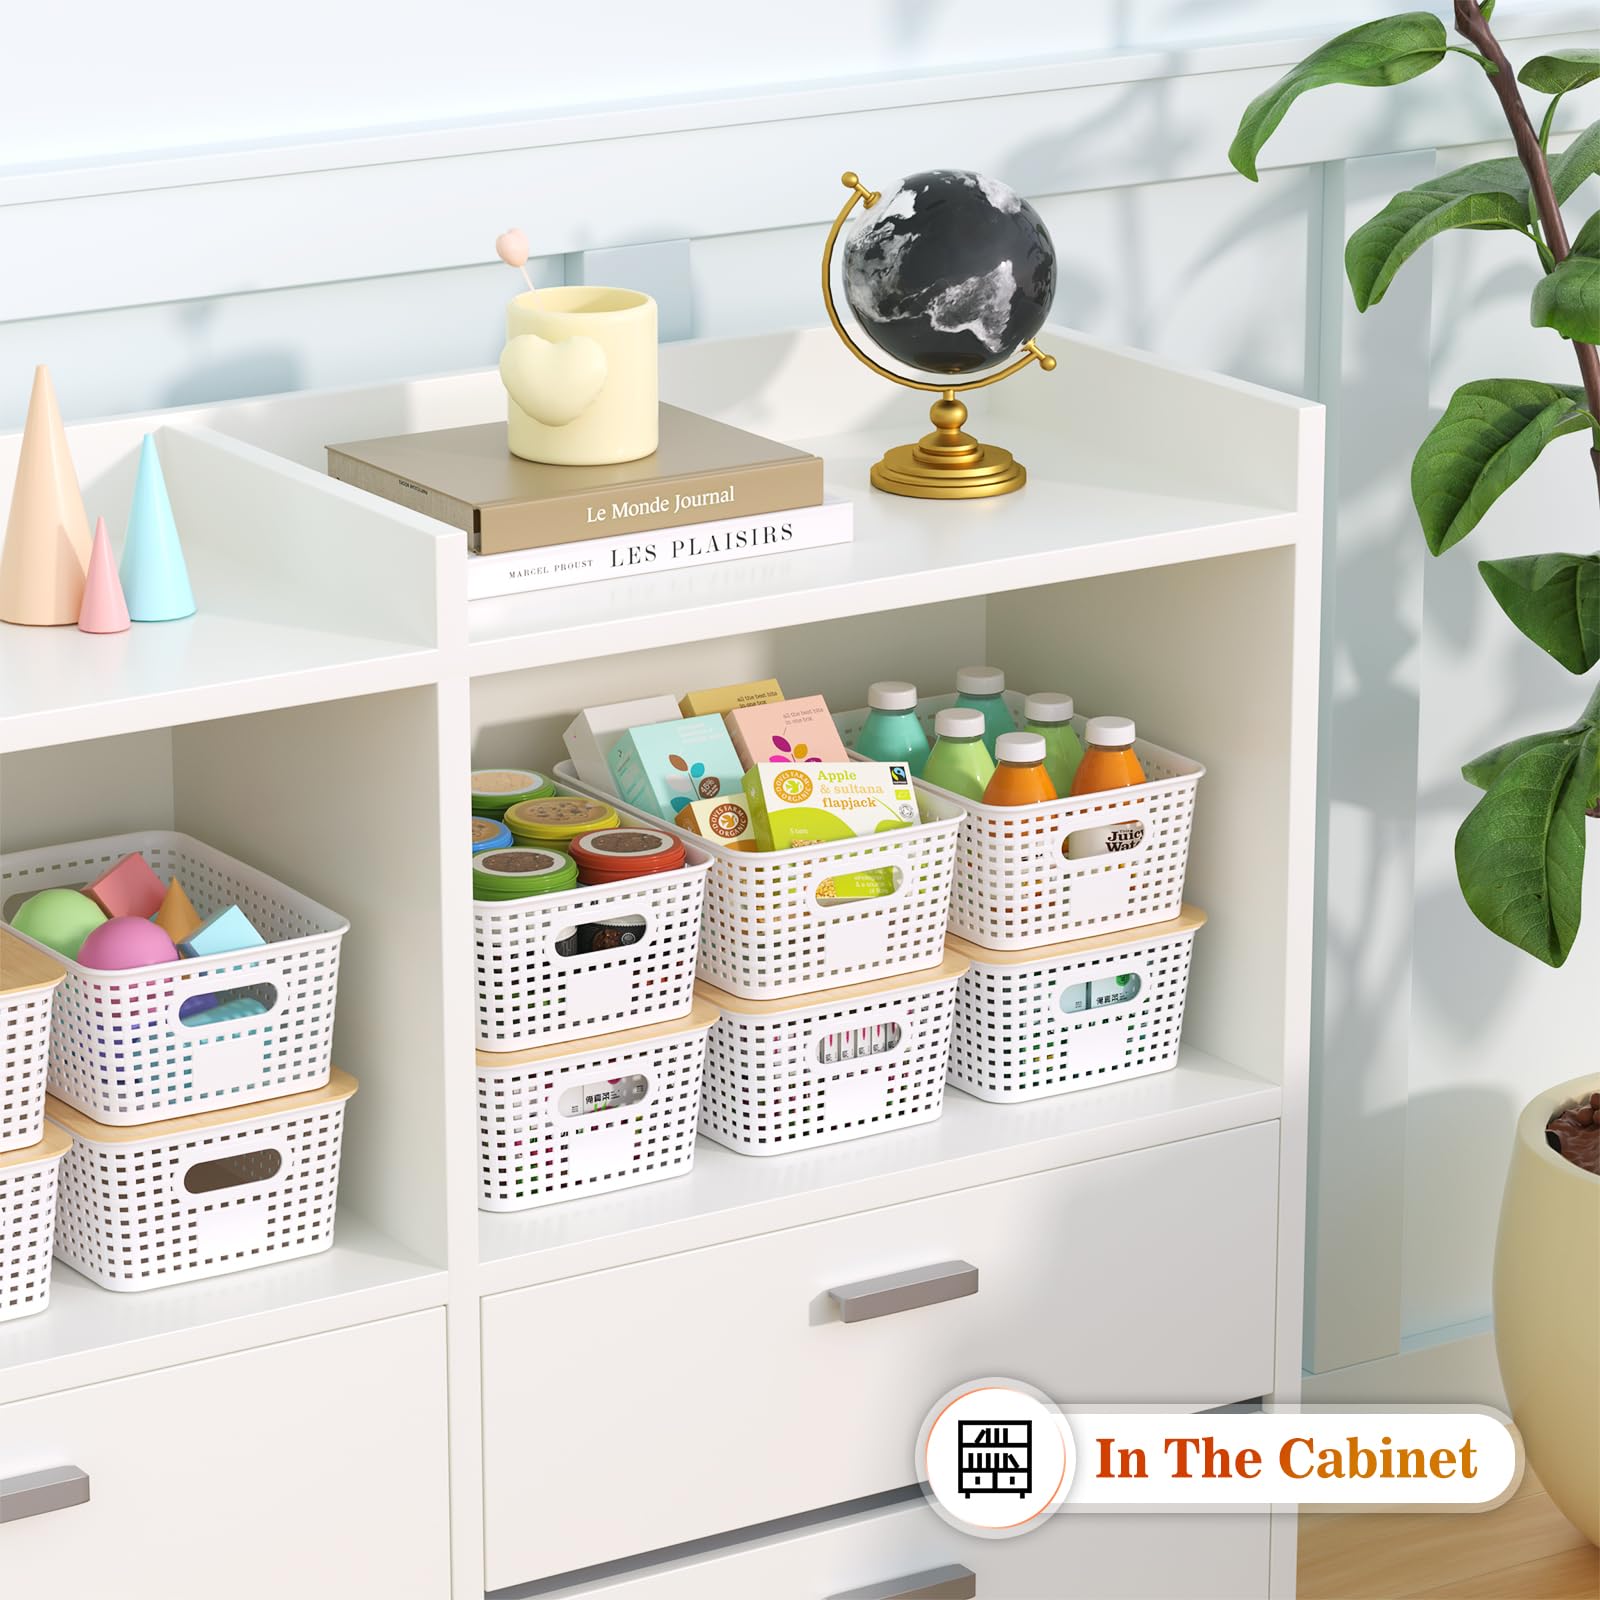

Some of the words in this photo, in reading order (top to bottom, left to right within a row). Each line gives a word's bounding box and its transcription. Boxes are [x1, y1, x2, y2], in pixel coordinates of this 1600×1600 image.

[586, 507, 606, 523] Le
[611, 496, 670, 520] Monde
[673, 485, 736, 513] Journal
[610, 544, 657, 568] LES
[671, 523, 794, 559] PLAISIRS
[508, 566, 550, 579] MARCEL
[554, 559, 594, 573] PROUST
[817, 769, 857, 783] Apple
[820, 785, 831, 794] &
[834, 783, 884, 794] sultana
[822, 797, 877, 810] flapjack
